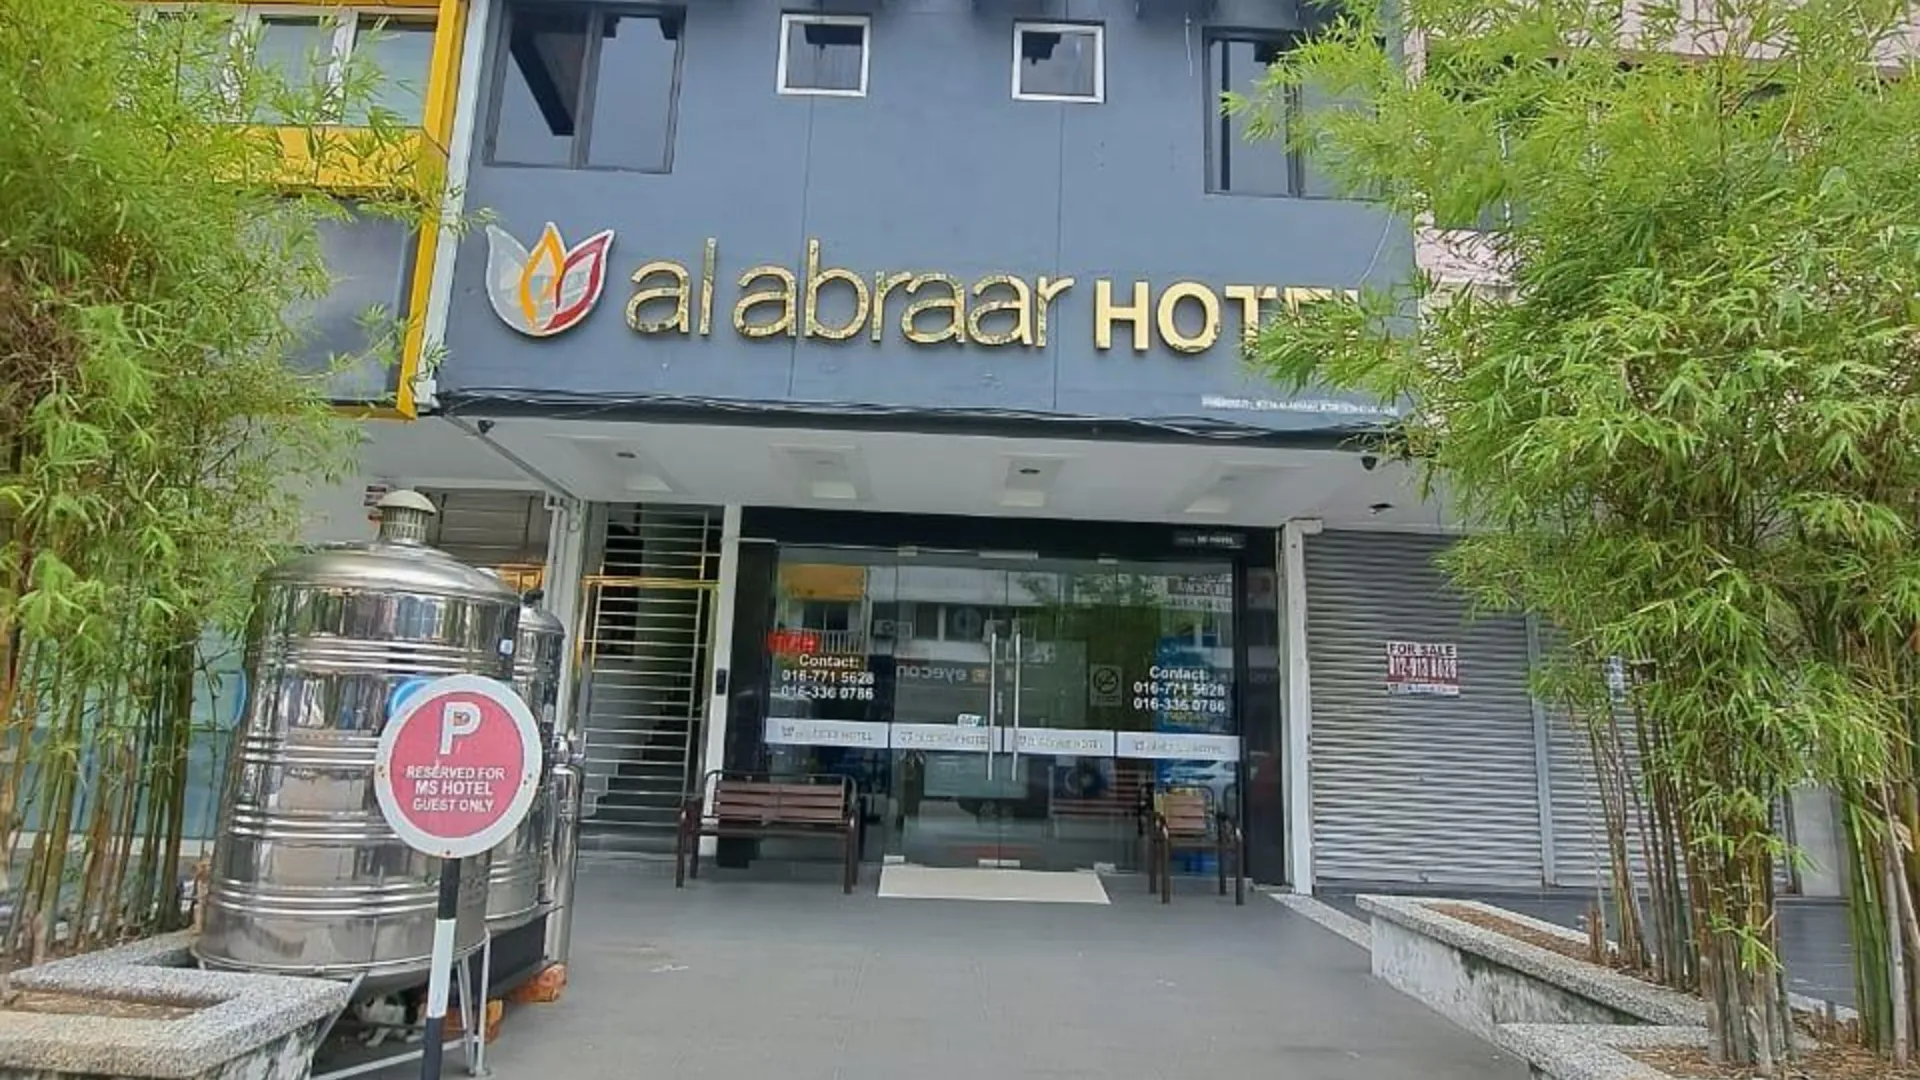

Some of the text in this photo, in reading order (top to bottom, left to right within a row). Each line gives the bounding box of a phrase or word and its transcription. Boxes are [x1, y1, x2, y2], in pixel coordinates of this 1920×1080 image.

[625, 236, 717, 337] al
[732, 237, 1075, 349] abraar
[1389, 643, 1455, 657] FOR SALE
[799, 653, 860, 669] Contact:
[781, 669, 836, 683] 016-771
[440, 701, 482, 755] P
[405, 765, 505, 781] RESERVED FOR
[415, 780, 494, 796] MS HOTEL
[413, 798, 495, 813] GUEST ONLY
